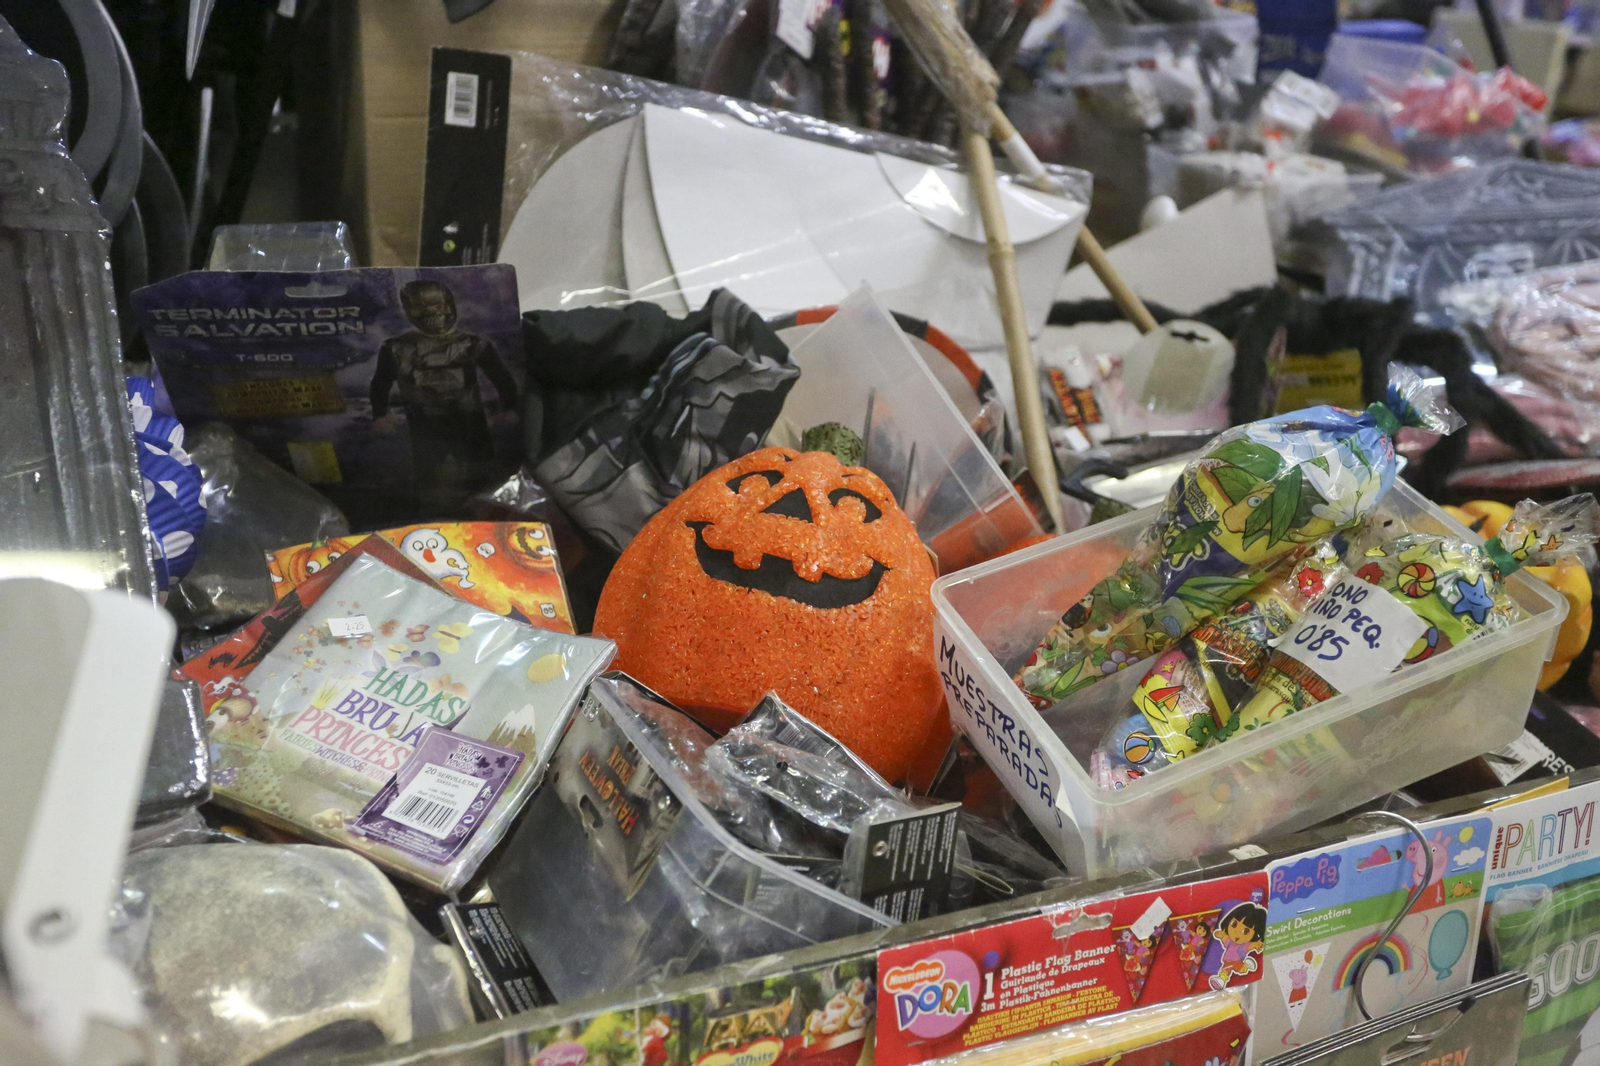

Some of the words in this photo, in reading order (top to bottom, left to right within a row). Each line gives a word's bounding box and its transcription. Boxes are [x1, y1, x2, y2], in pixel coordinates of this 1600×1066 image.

[147, 306, 362, 321] TERMINATOR
[153, 320, 365, 337] SALVATION
[236, 353, 294, 362] T-600
[363, 666, 467, 725] HADAS
[939, 635, 1049, 777] MUESTRAS
[332, 688, 428, 748] BRUJA
[289, 704, 413, 772] PRINCES
[940, 671, 1063, 829] PREPARADAS
[425, 766, 438, 776] 20
[437, 772, 480, 788] SERVILLETAS
[578, 751, 640, 836] HALLOWEEN
[1491, 826, 1504, 870] unique
[1501, 801, 1596, 869] PARTY!
[1271, 869, 1314, 899] Peppa
[1316, 858, 1339, 885] Pig
[1489, 872, 1506, 881] FLAG
[1507, 866, 1533, 877] BANNER
[1266, 921, 1291, 938] Swirl
[1294, 907, 1352, 929] Decorations
[888, 965, 941, 986] NICKELODEON
[1000, 972, 1047, 989] Guirlande
[1049, 968, 1060, 977] de
[1061, 957, 1106, 973] Drapeaux
[1001, 961, 1042, 980] Plastic
[1045, 953, 1072, 969] Flag
[1074, 944, 1117, 961] Banner
[983, 972, 995, 1000] 1
[999, 977, 1098, 1010] Plastik-Fahnenbanner
[1000, 990, 1012, 1000] en
[1013, 978, 1055, 996] Plastique
[895, 979, 974, 1031] DORA
[980, 1001, 996, 1013] 3m
